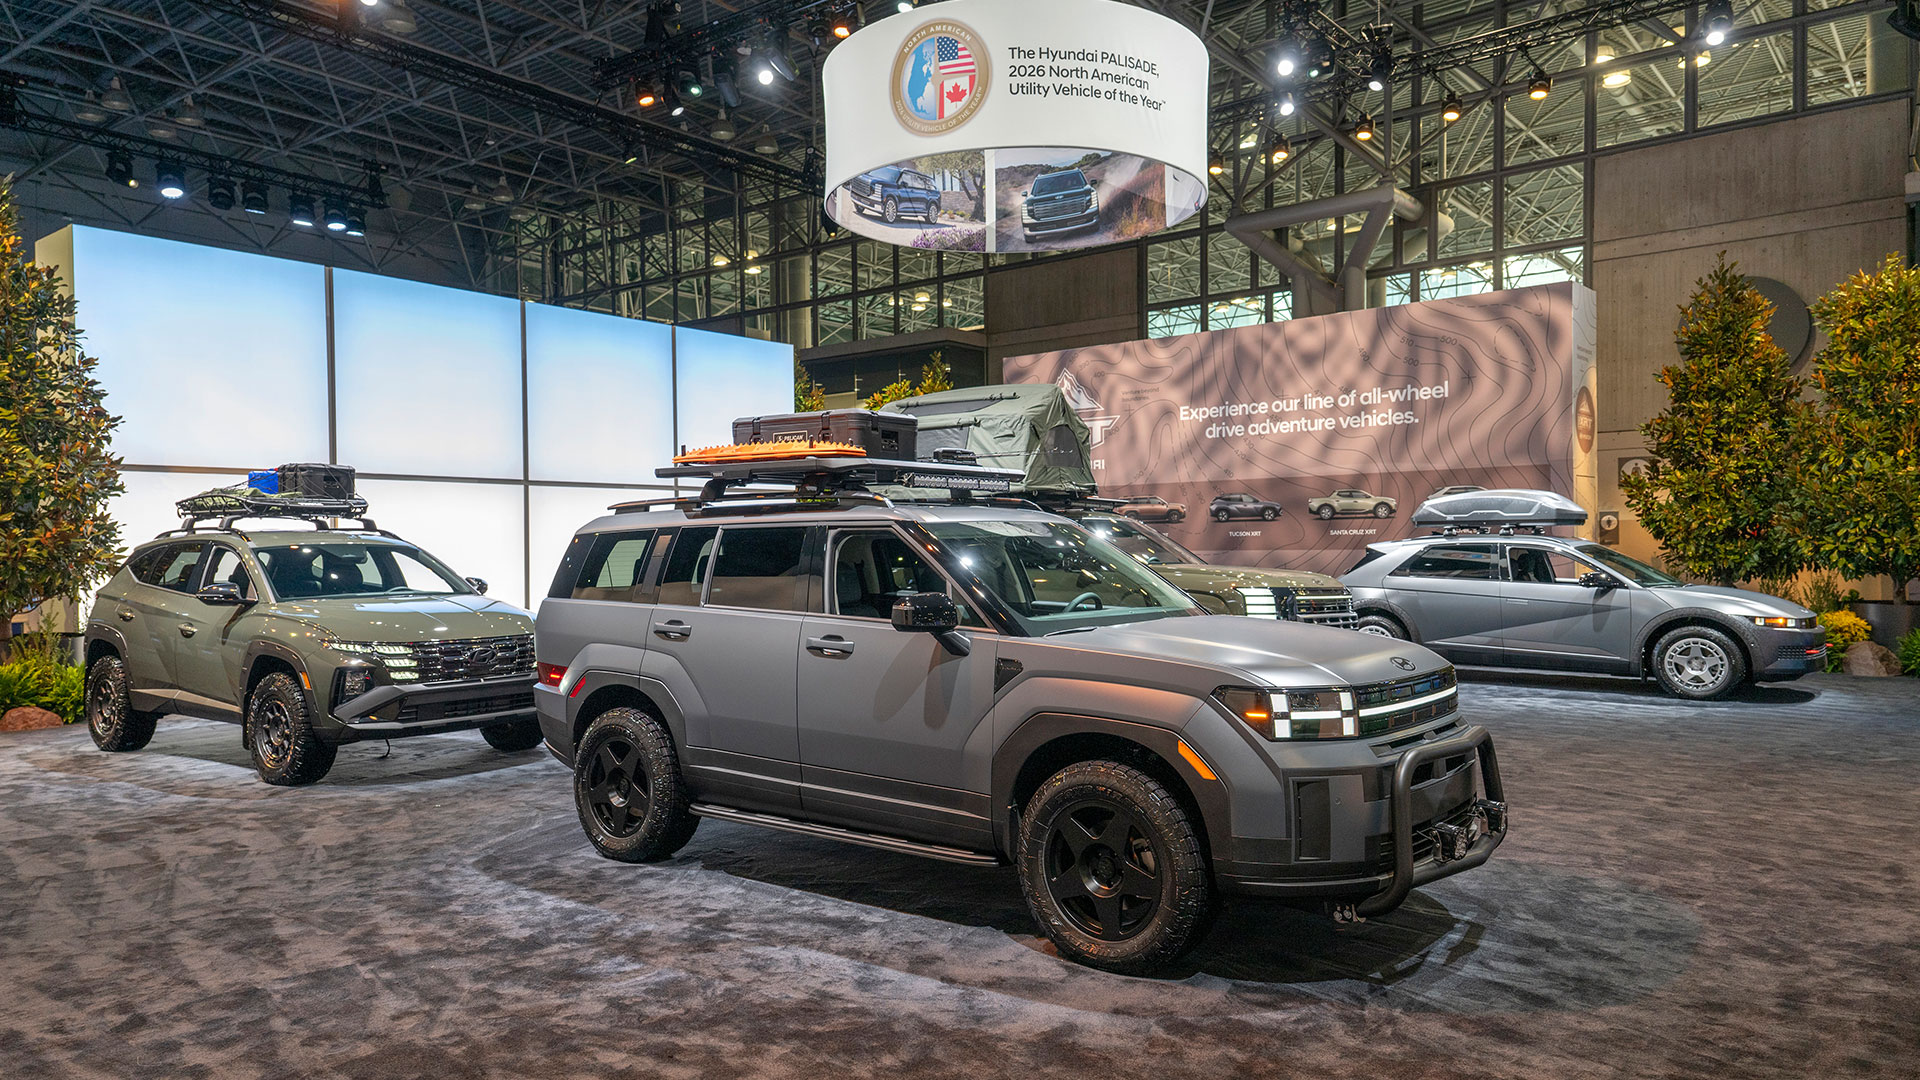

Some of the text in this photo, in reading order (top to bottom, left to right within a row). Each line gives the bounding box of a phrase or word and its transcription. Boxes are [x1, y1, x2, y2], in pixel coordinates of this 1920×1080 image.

[903, 25, 973, 54] NORTH AMERICAN
[1008, 46, 1160, 79] The Hyundai PALISADE,
[1008, 65, 1149, 91] 2026 North American
[1009, 81, 1050, 98] Utility
[1052, 83, 1102, 99] Vehicle
[1104, 88, 1117, 101] of
[1119, 90, 1138, 105] the
[921, 123, 946, 132] VEHICLE
[948, 118, 957, 128] OF
[959, 109, 970, 121] THE
[1179, 401, 1269, 422] Experience
[1271, 398, 1301, 413] our
[1304, 393, 1335, 410] line
[1337, 389, 1357, 408] of
[1359, 380, 1449, 405] all-wheel
[1205, 408, 1420, 439] drive adventure vehicles.
